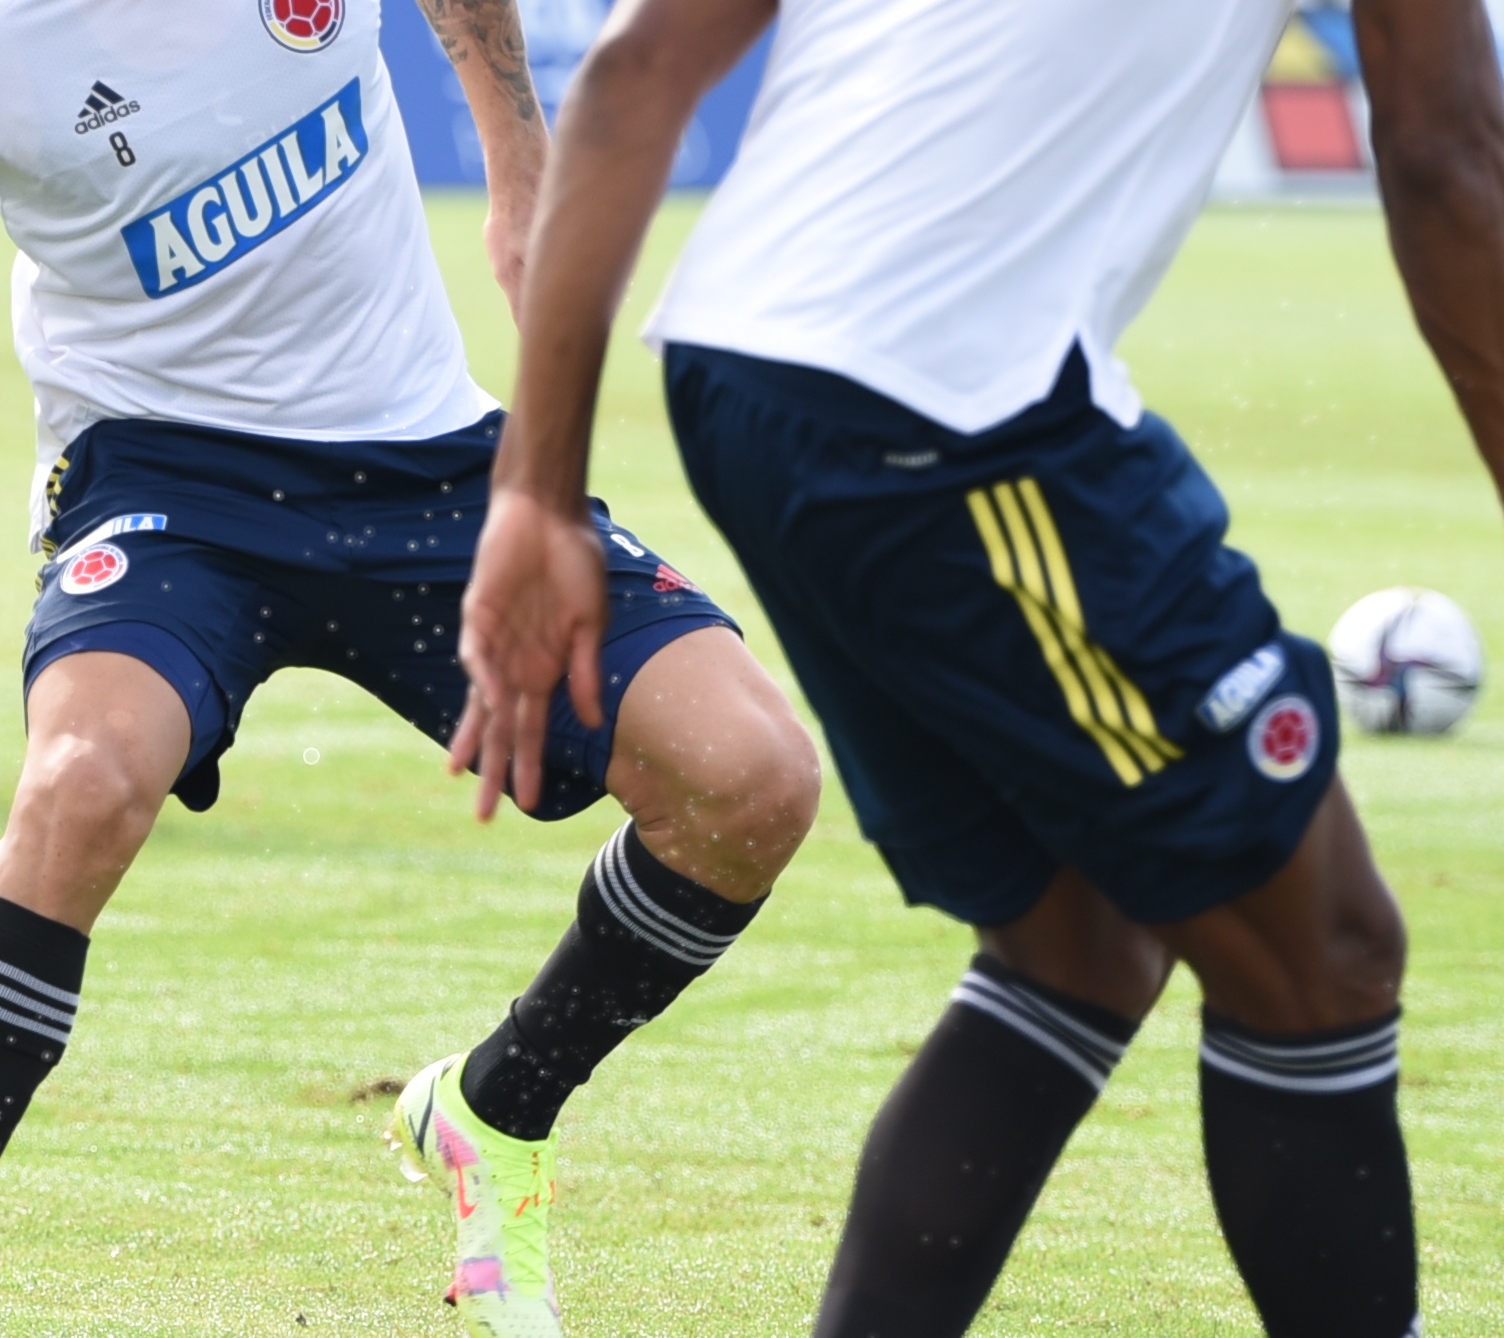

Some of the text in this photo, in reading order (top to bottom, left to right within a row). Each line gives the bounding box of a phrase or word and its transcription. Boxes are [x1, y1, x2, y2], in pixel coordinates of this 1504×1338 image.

[74, 99, 141, 135] adidas
[108, 130, 137, 168] 8
[148, 100, 362, 292] AGUILA
[609, 533, 645, 558] 8
[1206, 649, 1282, 731] AGUILA
